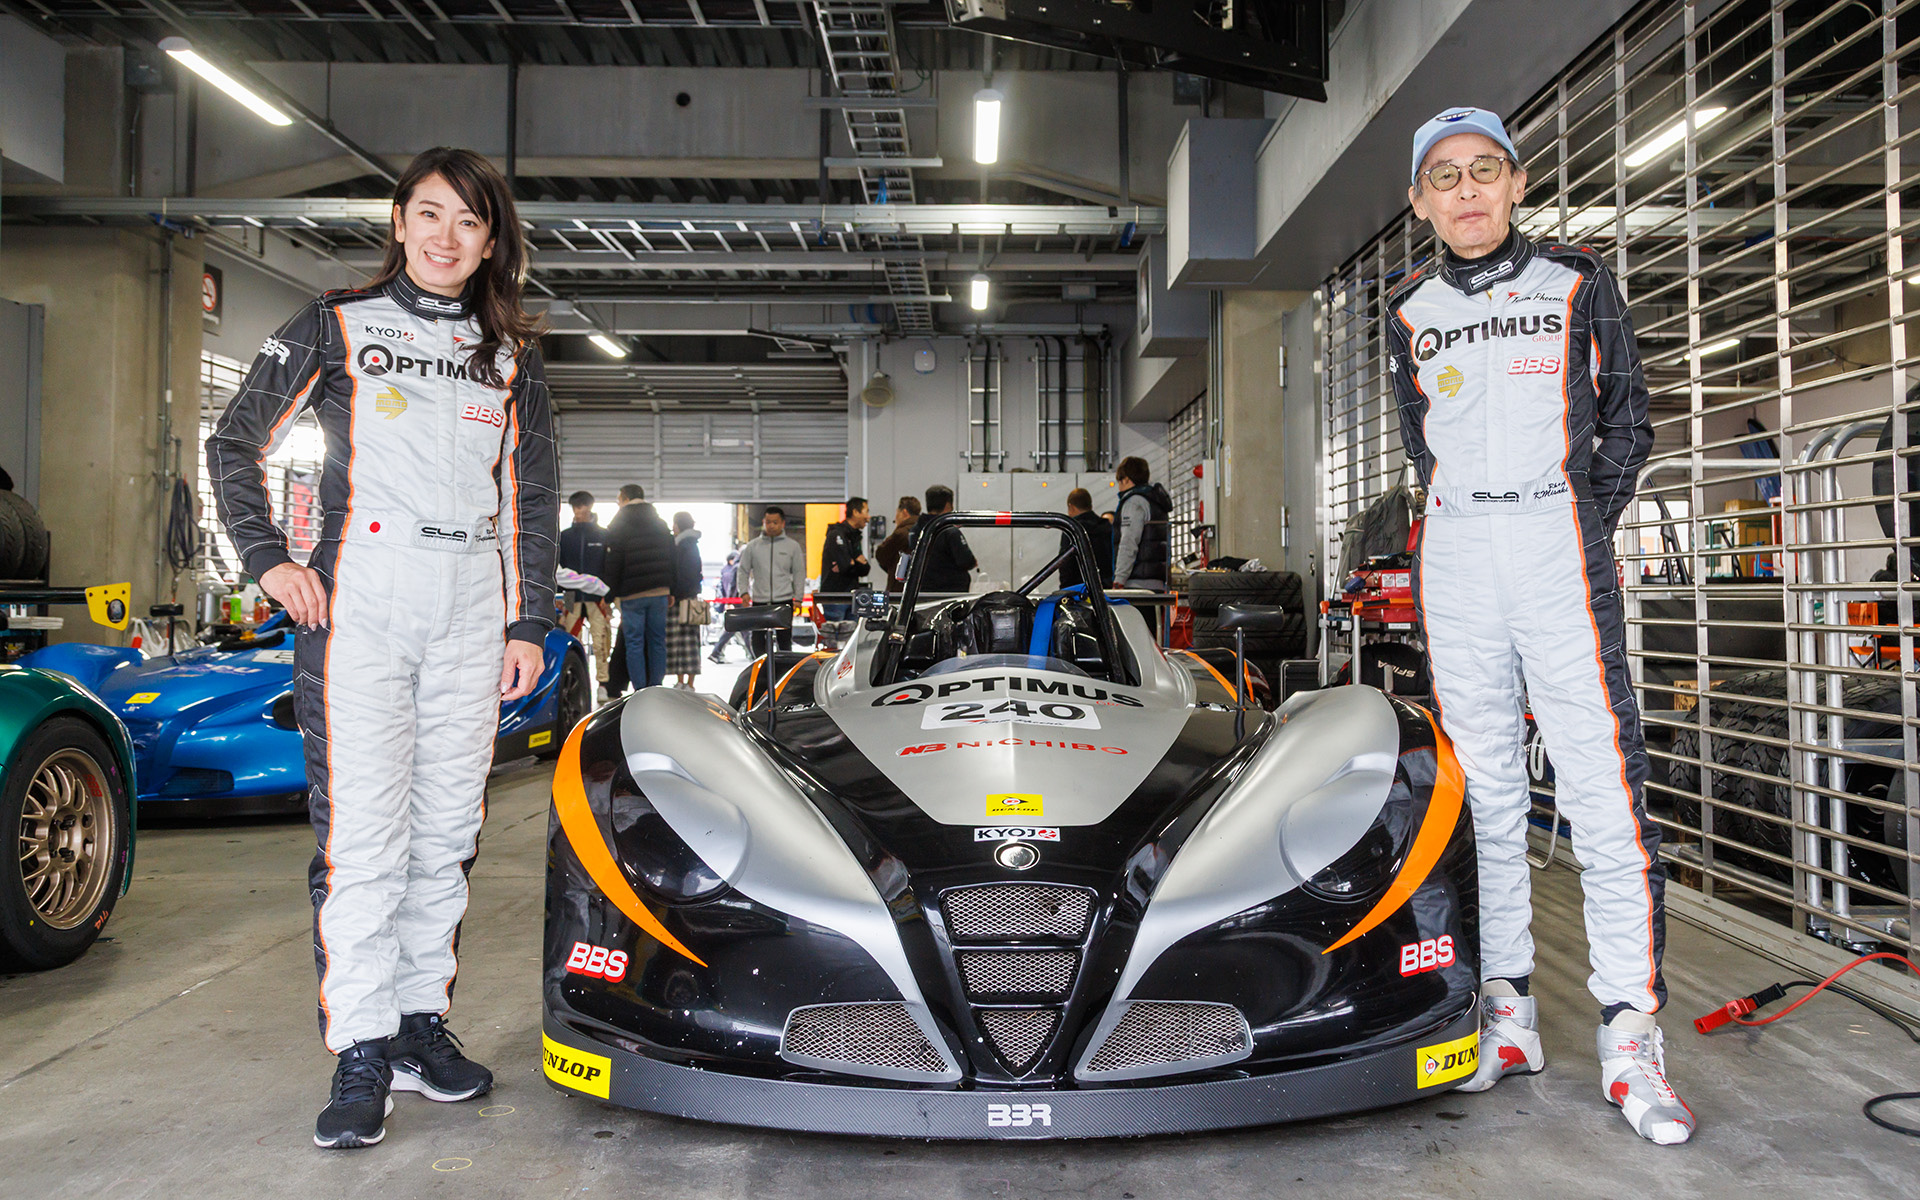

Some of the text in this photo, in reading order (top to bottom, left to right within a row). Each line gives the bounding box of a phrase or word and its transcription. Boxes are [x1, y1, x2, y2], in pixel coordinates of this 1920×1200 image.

[1415, 313, 1563, 362] OPTIMUS
[1532, 334, 1563, 343] GROUP
[357, 343, 504, 387] OPTIM
[1507, 355, 1560, 375] BBS
[460, 402, 504, 428] BBS
[1377, 660, 1417, 678] SFIA
[871, 676, 1145, 708] OPTIMUS
[940, 699, 1087, 721] 240
[565, 941, 629, 983] BBS
[1399, 934, 1456, 977] BBS
[543, 1046, 601, 1081] UNLOP
[1441, 1042, 1479, 1071] DUN
